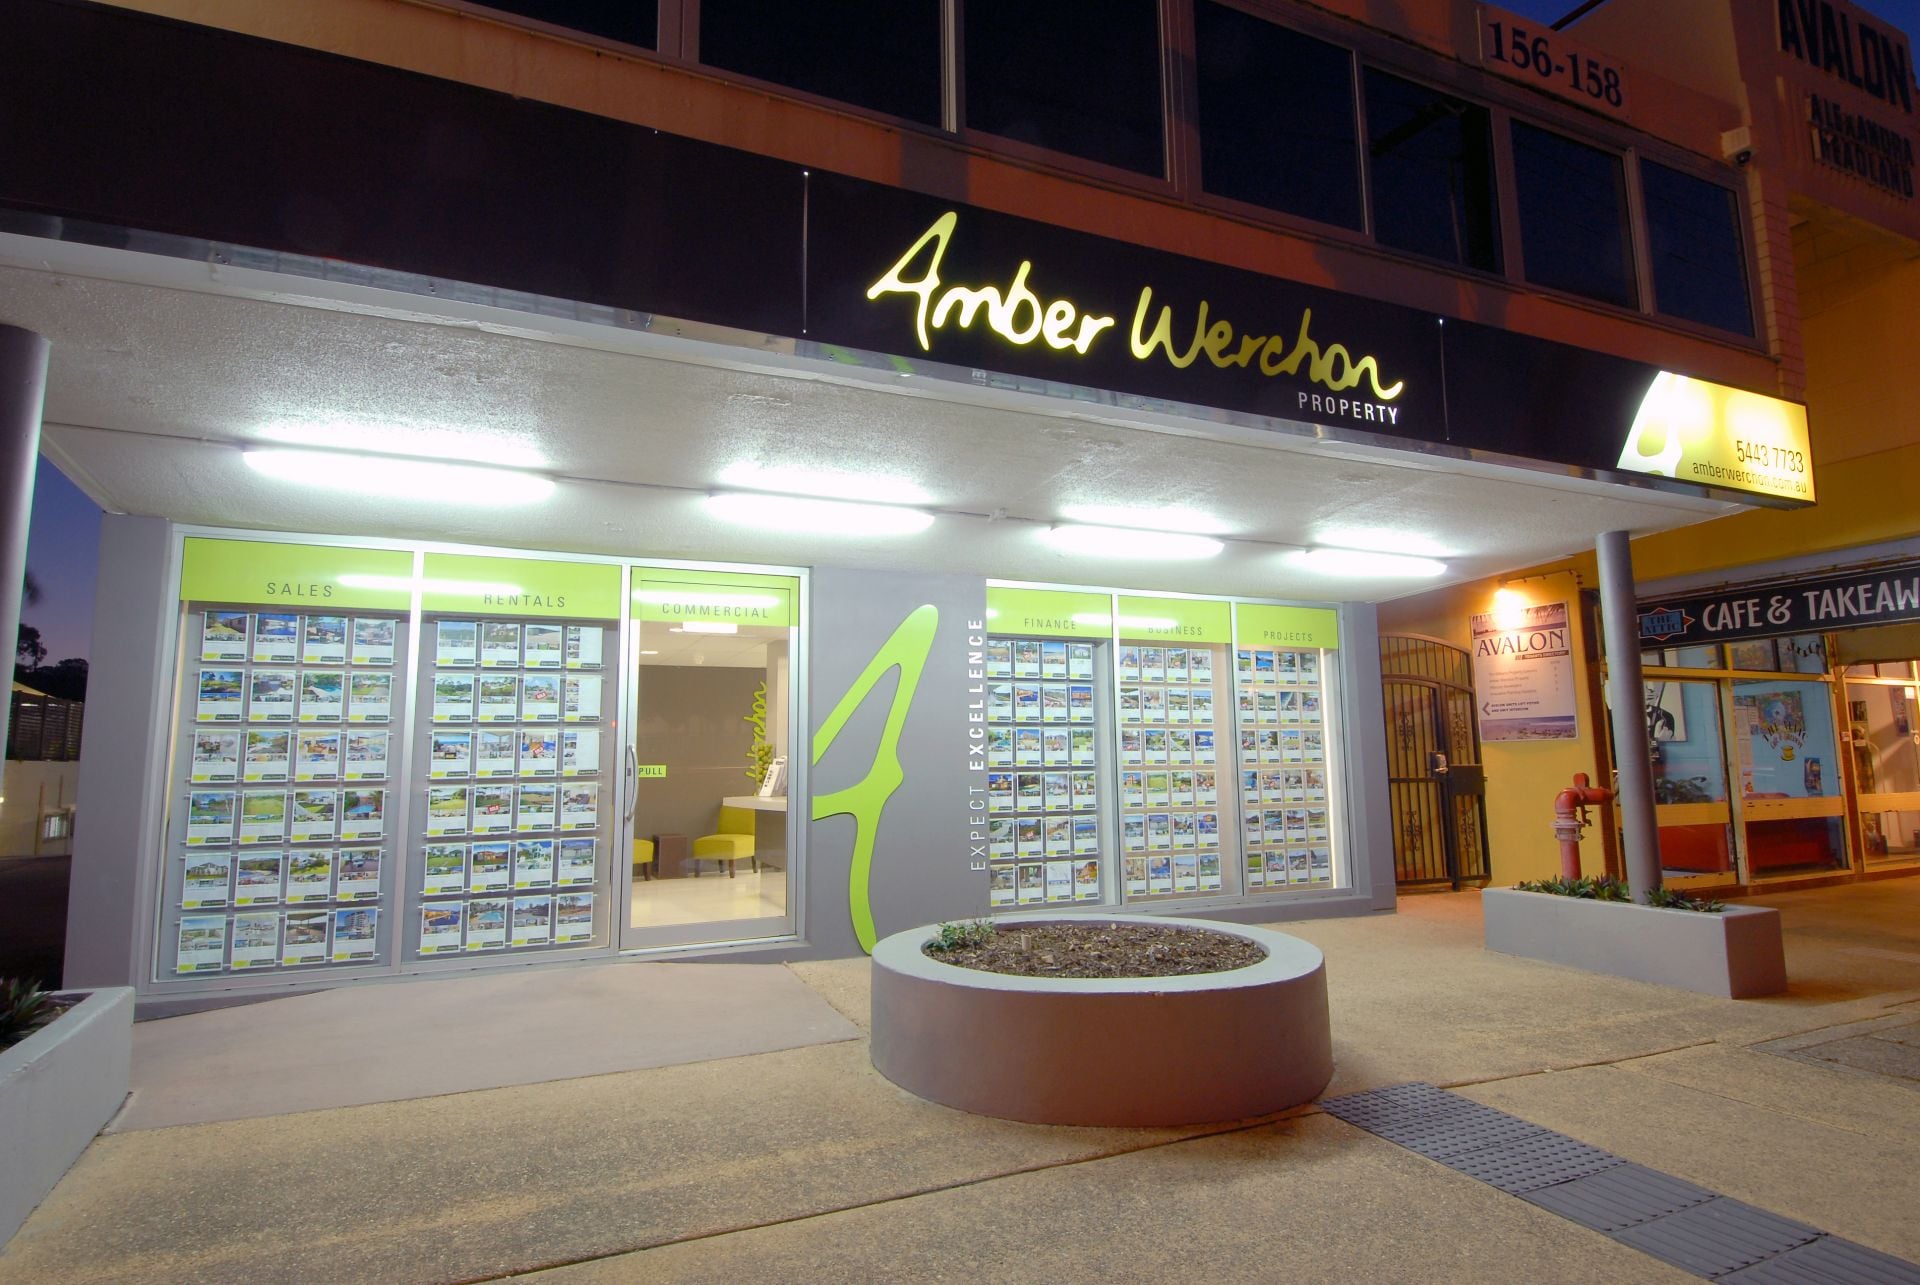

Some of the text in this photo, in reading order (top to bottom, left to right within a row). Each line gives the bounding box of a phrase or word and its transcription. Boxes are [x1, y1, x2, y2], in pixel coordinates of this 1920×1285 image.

[1488, 21, 1624, 109] 156-158
[1779, 0, 1912, 113] AVALON
[866, 210, 1404, 400] Amber Werchon
[1297, 391, 1400, 425] PROPERTY
[1736, 440, 1804, 473] 5443 7733
[266, 582, 333, 598] SALES
[484, 593, 566, 608] RENTALS
[662, 602, 769, 619] COMMERCIAL
[1023, 617, 1077, 630] FINANCE
[1702, 597, 1763, 632] CAFE
[1766, 595, 1792, 625] &
[1263, 630, 1314, 643] PROJECTS
[1477, 629, 1565, 658] AVALON
[967, 618, 986, 872] EXPECT EXCELLENCE
[638, 767, 664, 776] PULL
